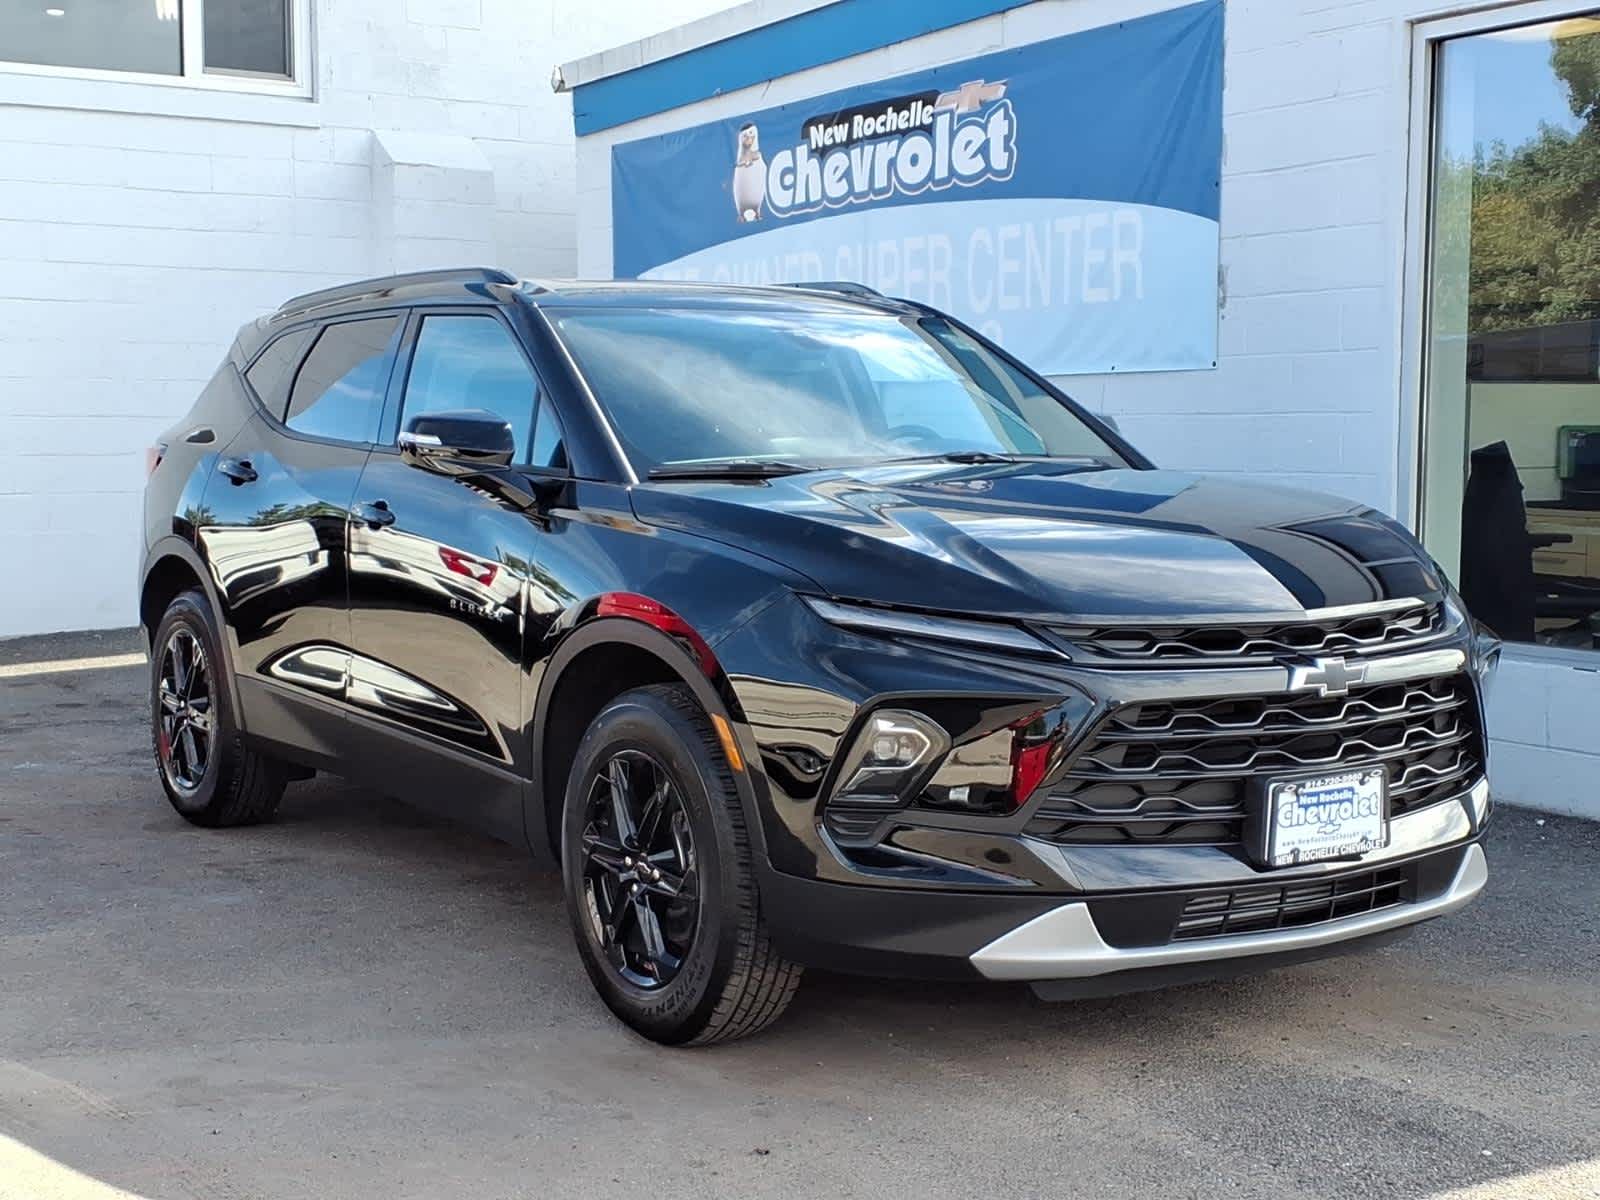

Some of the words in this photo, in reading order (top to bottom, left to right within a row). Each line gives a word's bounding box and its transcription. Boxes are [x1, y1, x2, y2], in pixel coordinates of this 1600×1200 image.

[810, 122, 849, 149] New
[853, 100, 934, 140] Rochelle
[768, 105, 1011, 209] Chevrolet
[967, 208, 1144, 314] CENTER
[1278, 792, 1378, 828] Chevrolet
[1299, 794, 1318, 805] New
[1275, 853, 1294, 866] NEW
[1299, 848, 1340, 862] ROCHELLE
